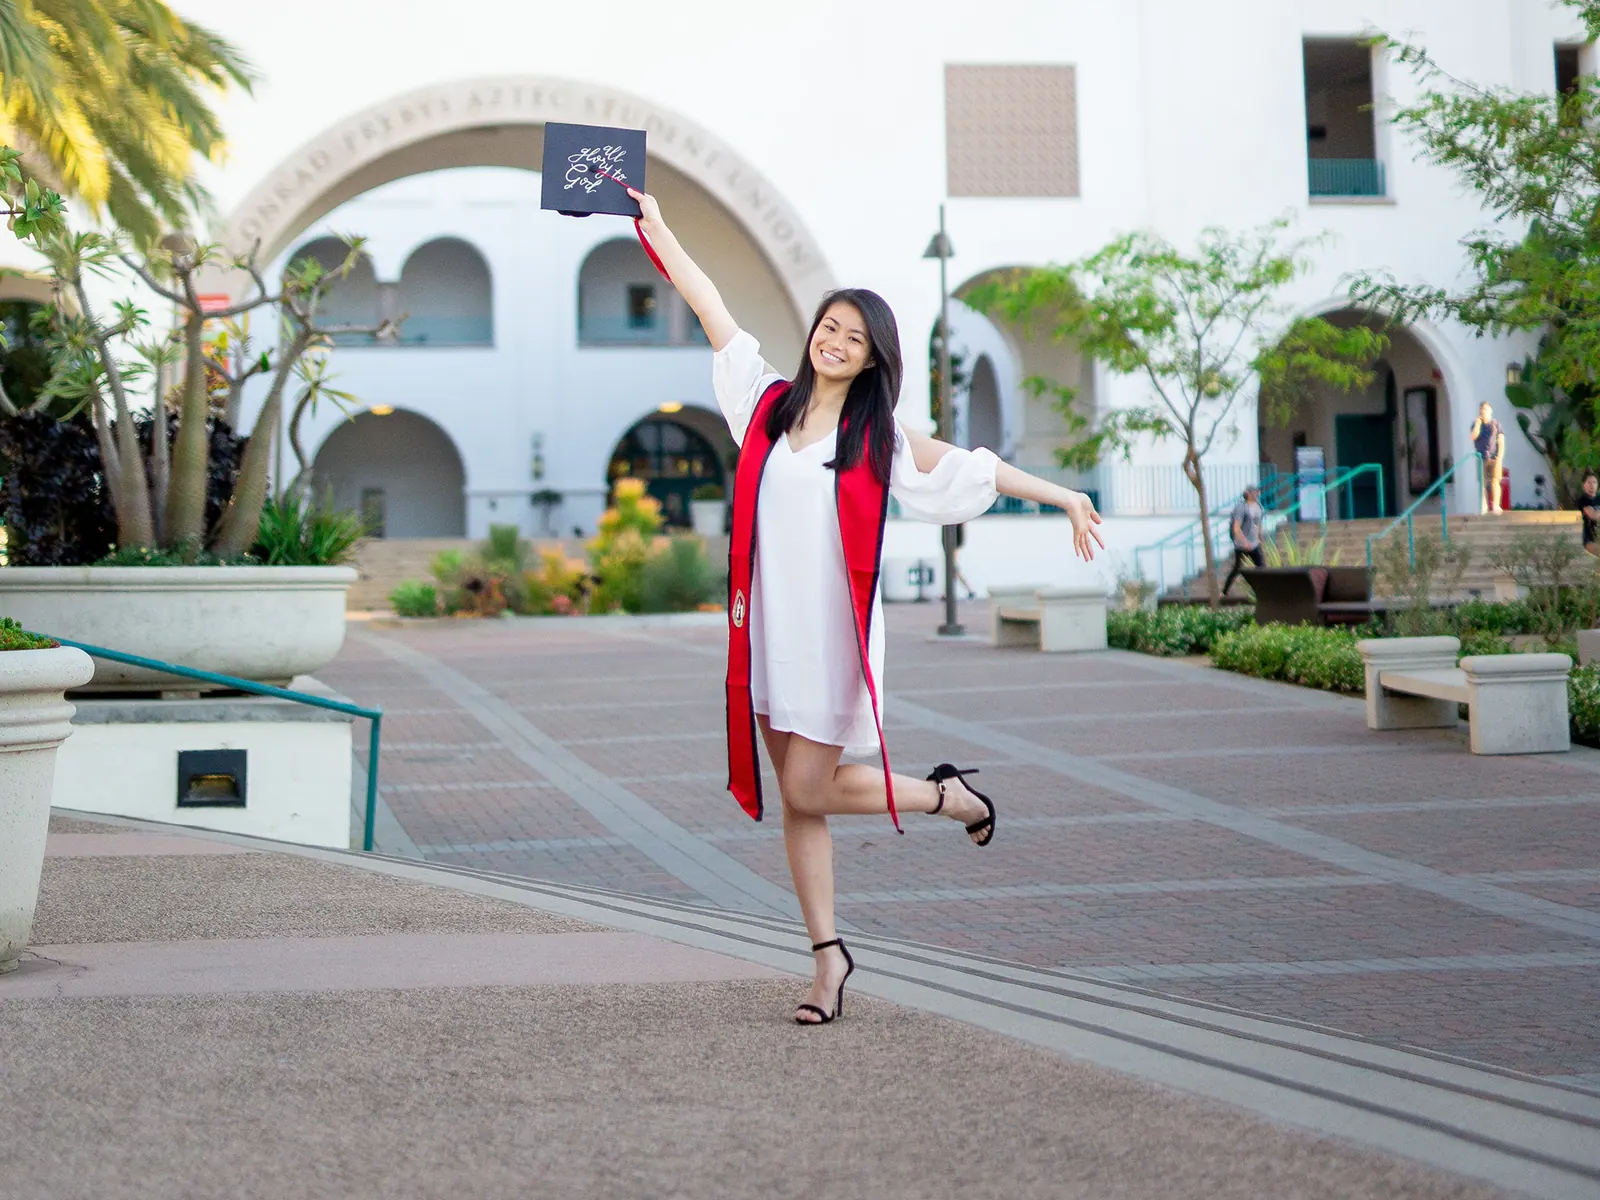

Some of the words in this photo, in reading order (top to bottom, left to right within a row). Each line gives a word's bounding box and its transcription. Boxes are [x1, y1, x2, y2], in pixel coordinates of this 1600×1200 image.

[567, 147, 614, 179] glory
[611, 168, 628, 182] to
[603, 145, 627, 163] all
[236, 149, 331, 243] ONRAD
[467, 84, 569, 112] AZTEC
[584, 95, 723, 170] STUDENT
[724, 168, 828, 278] UNION
[563, 163, 603, 194] God
